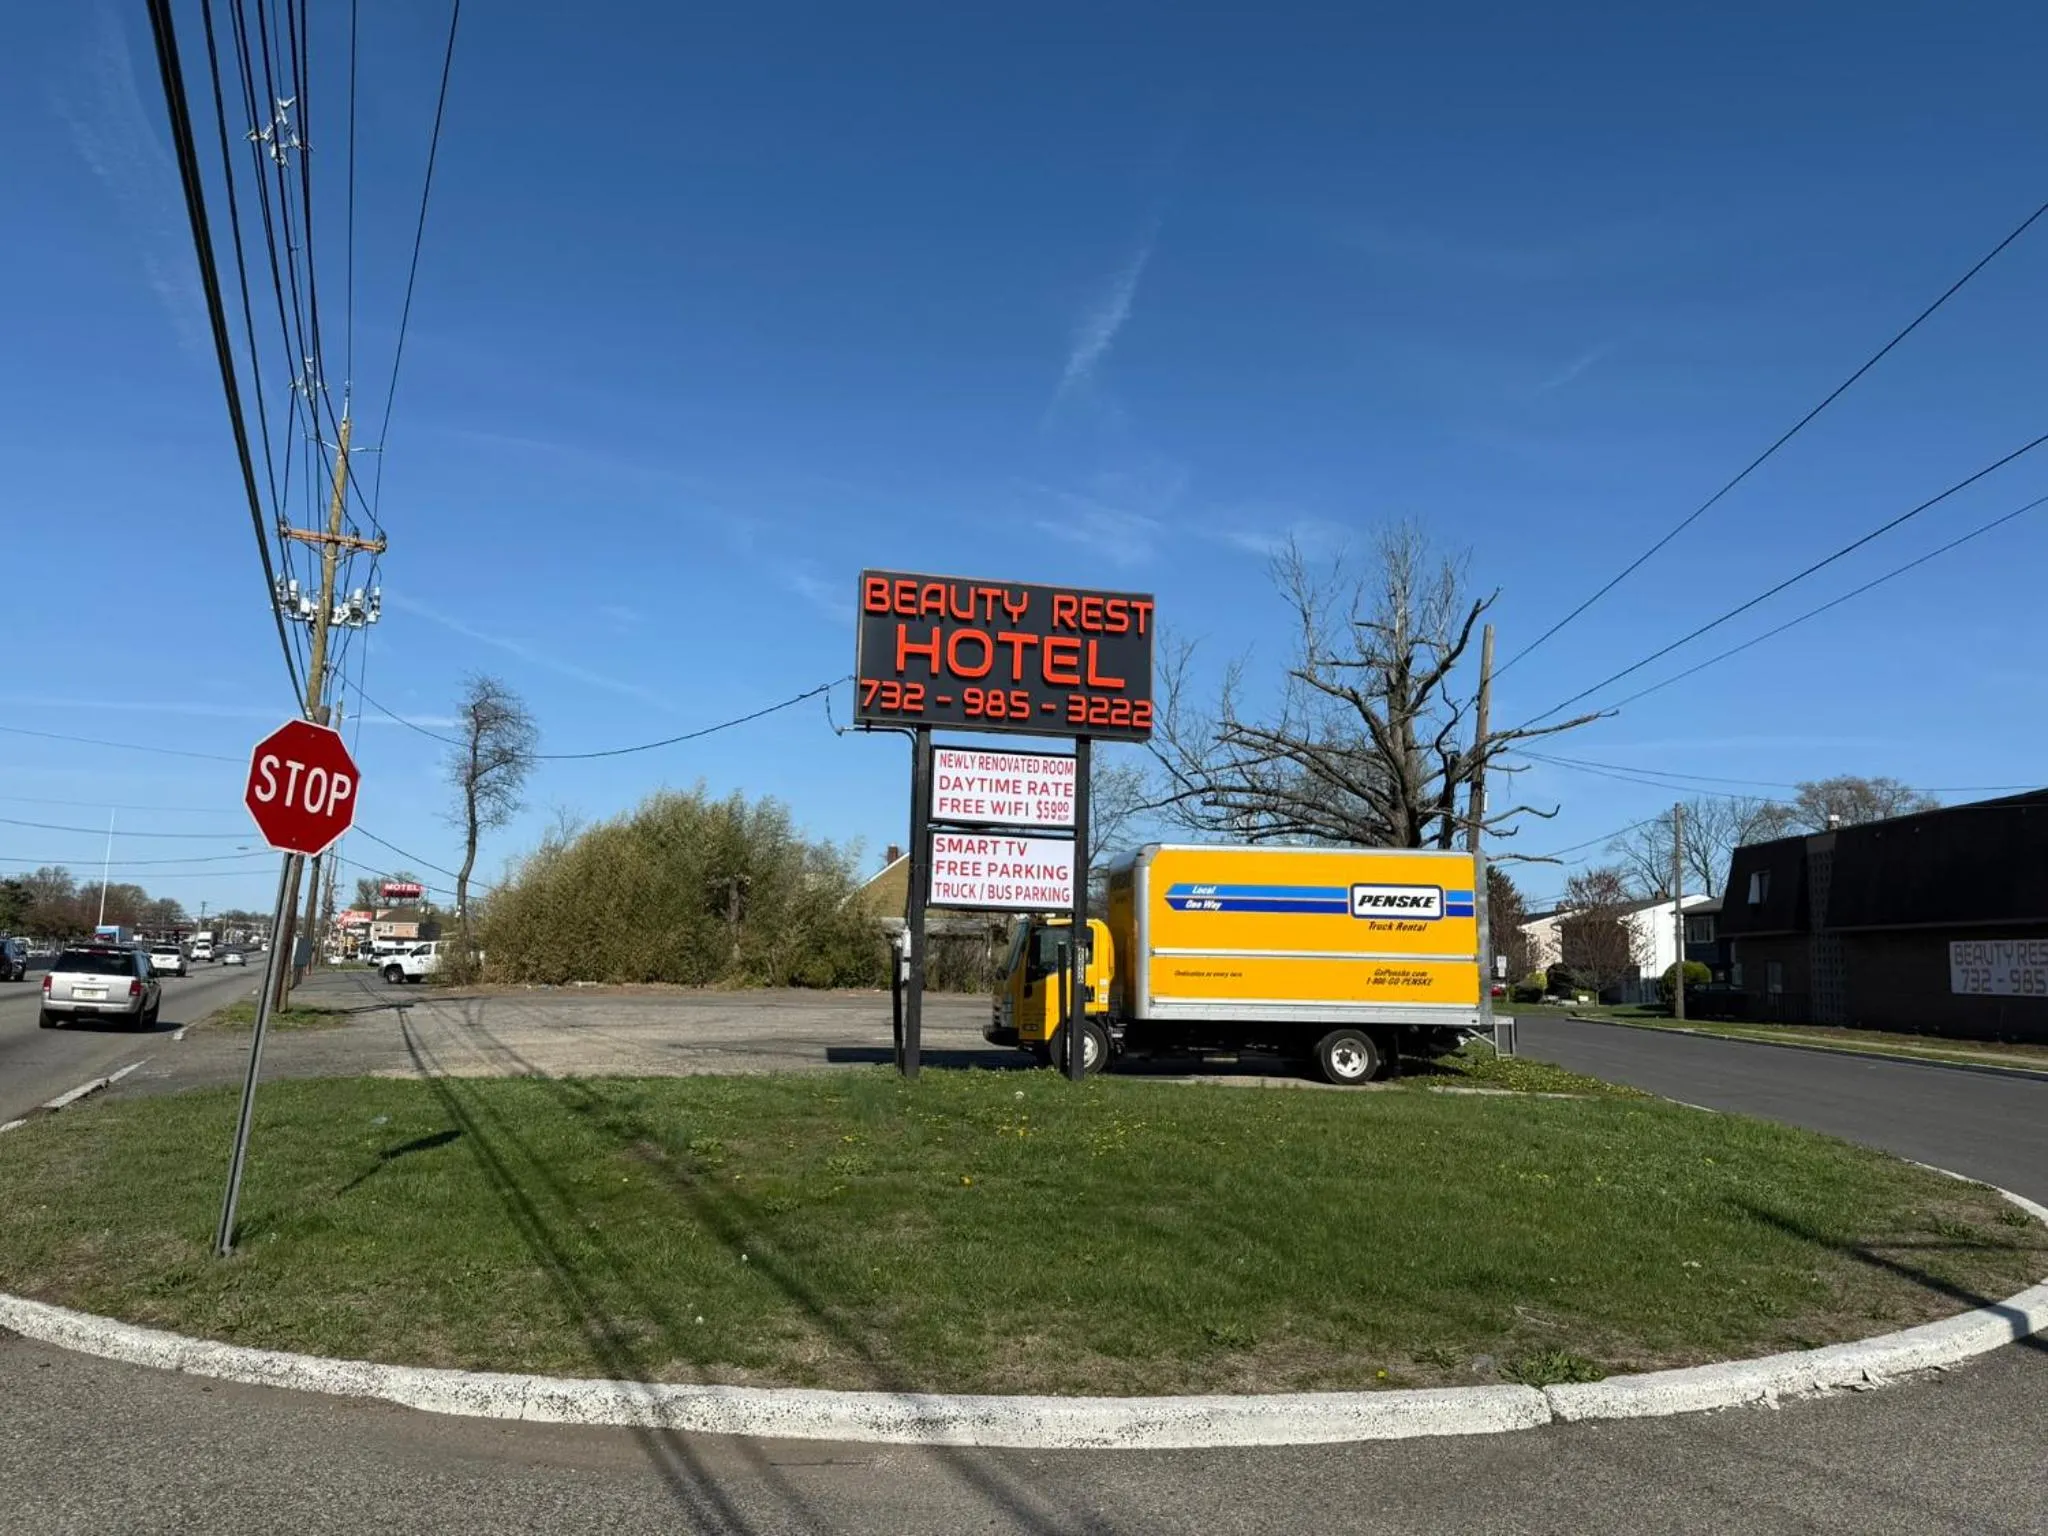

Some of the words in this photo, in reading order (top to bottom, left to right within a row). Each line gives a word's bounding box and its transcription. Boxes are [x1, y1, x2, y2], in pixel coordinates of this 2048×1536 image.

[864, 577, 1028, 623] BEAUTY
[1053, 594, 1153, 635] REST
[896, 624, 1125, 688] HOTEL
[860, 679, 925, 711] 732
[963, 687, 1030, 718] 985
[1067, 694, 1153, 728] 3222
[939, 752, 977, 770] NEWLY
[978, 755, 1039, 773] RENOVATED
[1042, 760, 1074, 776] ROOM
[255, 754, 351, 817] STOP
[939, 775, 1022, 794] DAYTIME
[1028, 780, 1074, 798] RATE
[939, 797, 985, 814] FREE
[991, 800, 1029, 817] WIFI
[935, 837, 1000, 855] SMART
[1005, 841, 1028, 857] TV
[935, 860, 982, 877] FREE
[988, 862, 1068, 881] PARKING
[384, 883, 420, 892] MOTEL
[935, 882, 976, 899] TRUCK
[988, 884, 1012, 900] BUS
[1015, 885, 1070, 903] PARKING
[1192, 885, 1216, 895] Local
[1203, 900, 1222, 911] Way
[1358, 894, 1436, 908] PENSKE
[1368, 921, 1393, 931] Truck
[1396, 922, 1428, 932] Rental
[1954, 943, 2013, 967] BEAUTY
[1960, 968, 1993, 992] 732
[2010, 969, 2046, 994] 985
